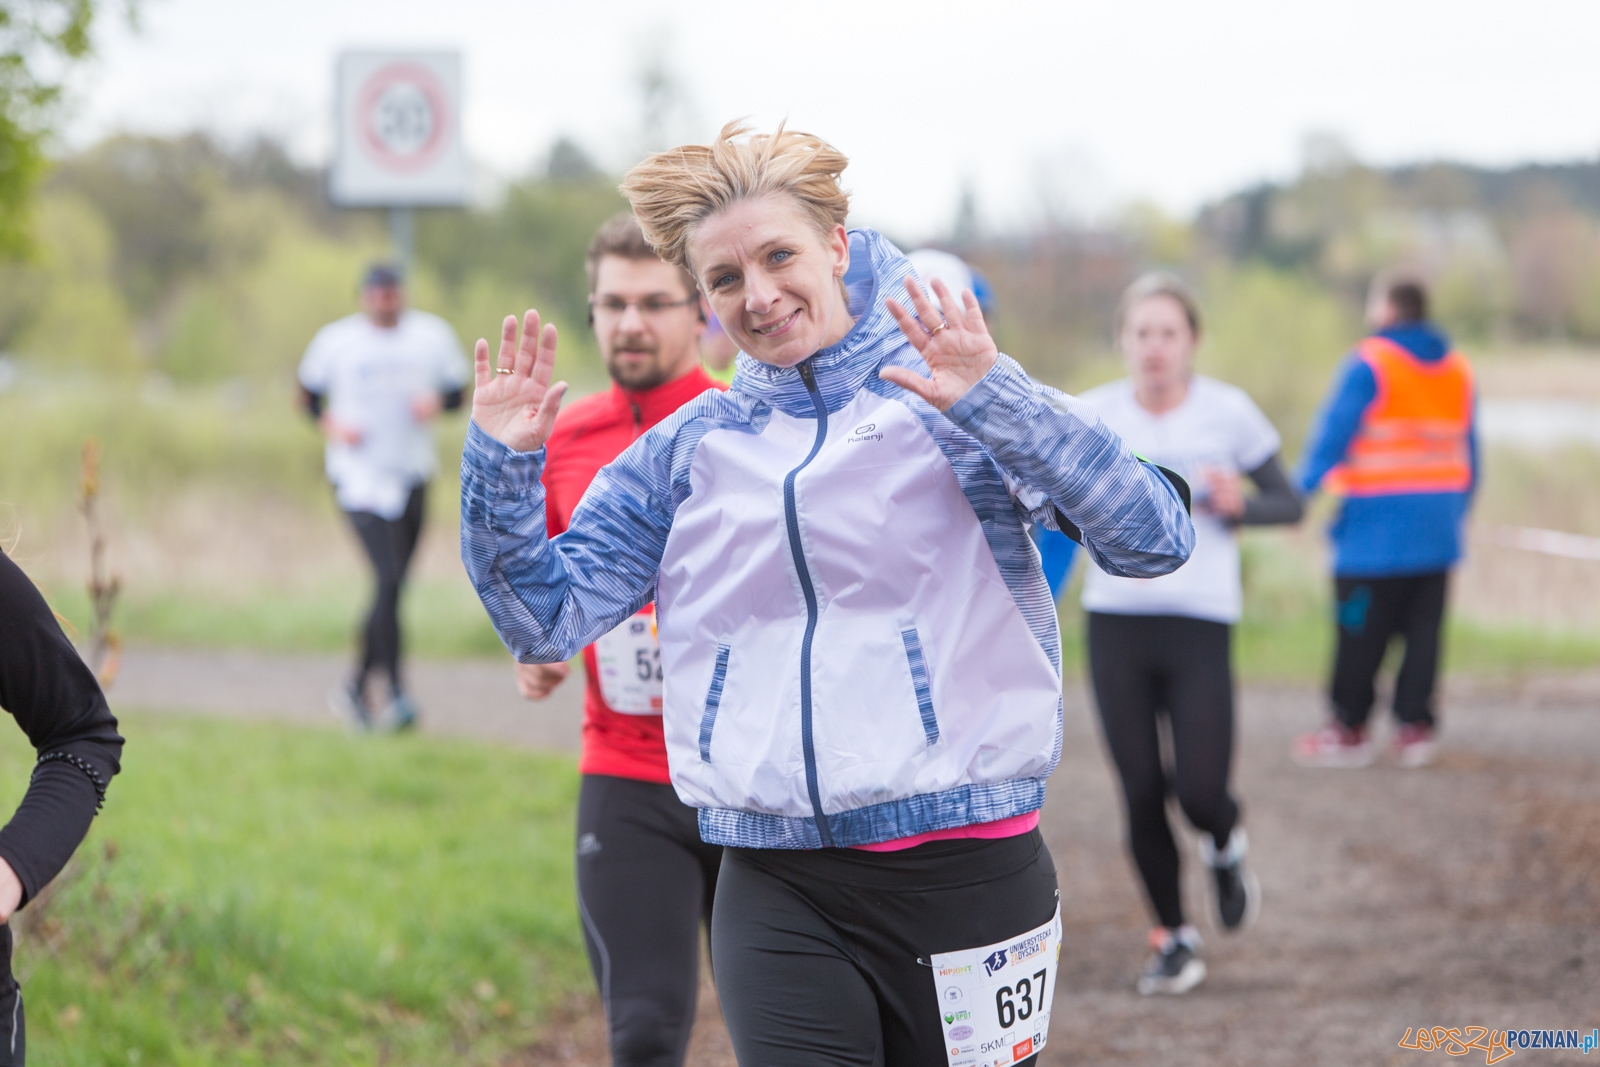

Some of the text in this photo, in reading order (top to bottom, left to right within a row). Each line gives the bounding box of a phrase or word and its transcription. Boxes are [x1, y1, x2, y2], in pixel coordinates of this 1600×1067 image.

[847, 432, 884, 444] Kalenji
[1009, 928, 1052, 954] UNIWERSYTECKA
[1010, 944, 1040, 963] ZADYSZKA
[996, 967, 1047, 1029] 637
[980, 1037, 1004, 1054] 5KM
